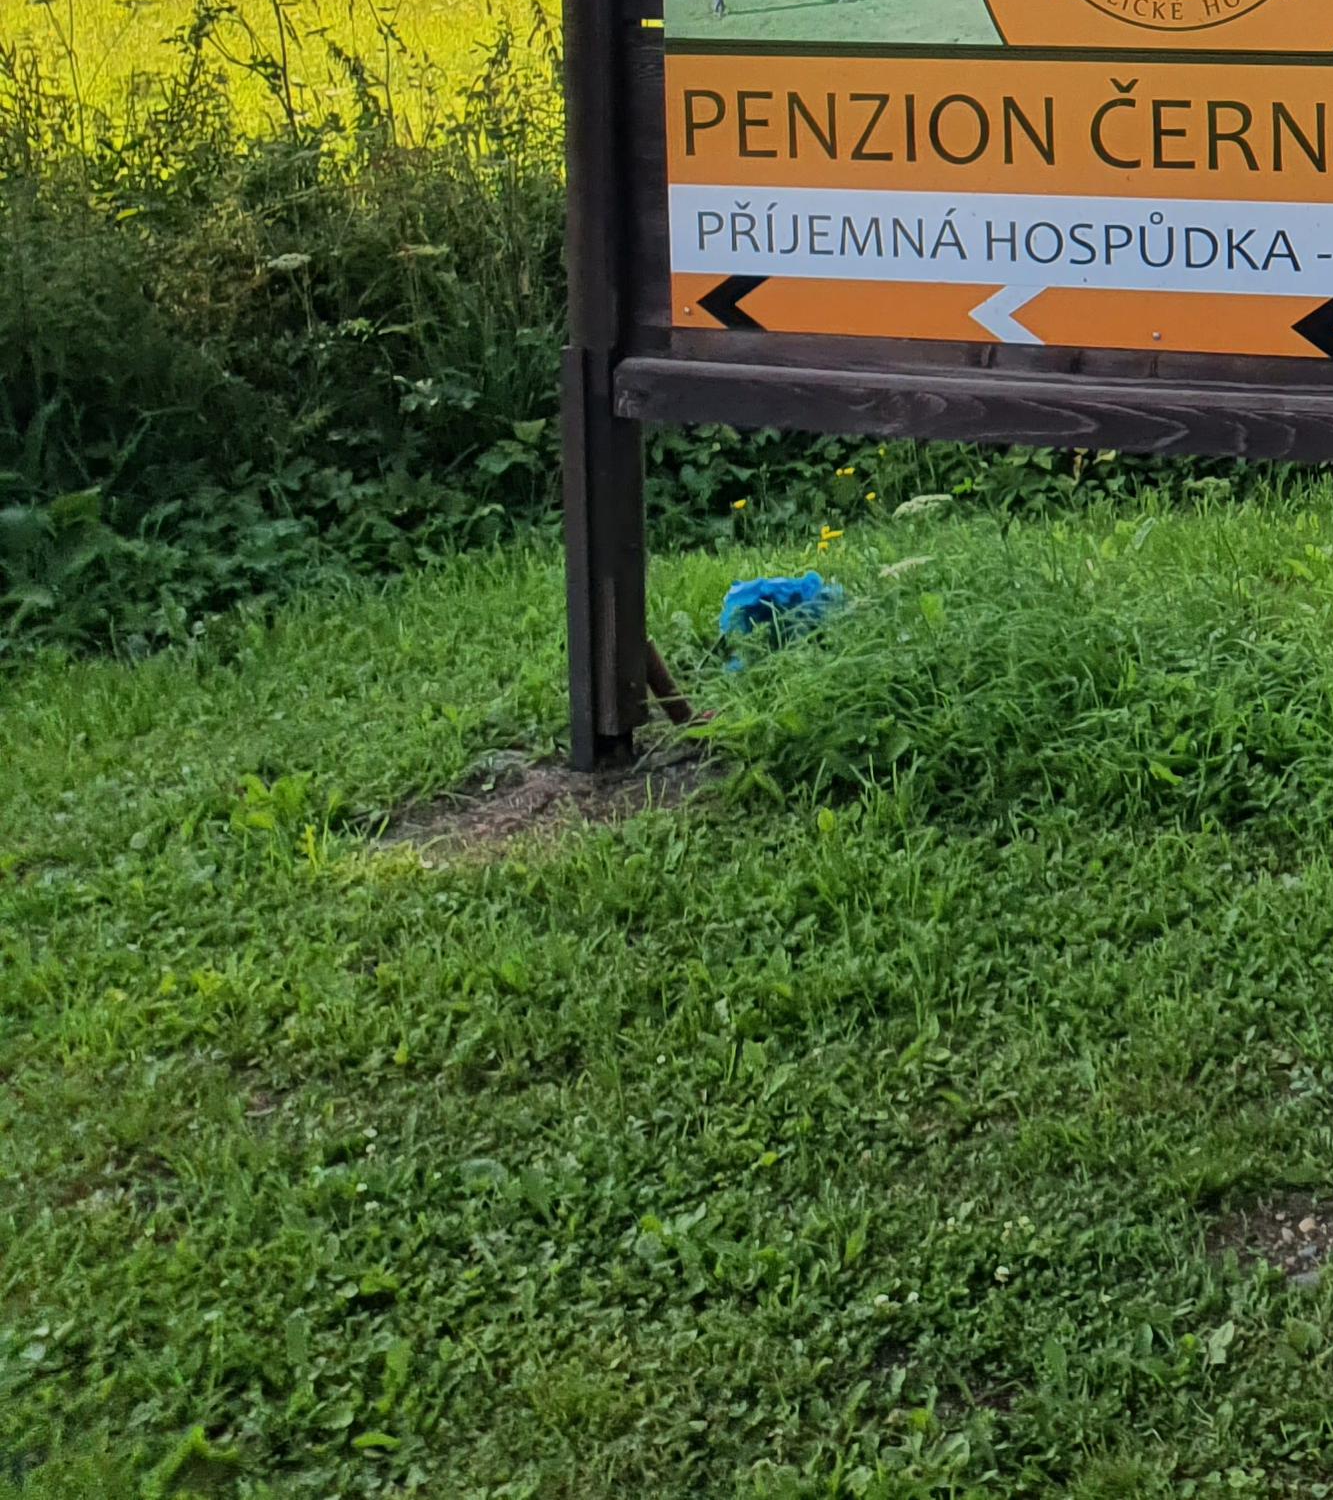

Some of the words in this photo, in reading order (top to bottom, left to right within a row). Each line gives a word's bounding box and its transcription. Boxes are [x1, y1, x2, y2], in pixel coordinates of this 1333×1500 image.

[683, 89, 1055, 167] PENZION
[697, 200, 968, 261] PŘÍJEMNÁ
[985, 211, 1302, 273] HOSPŮDKA
